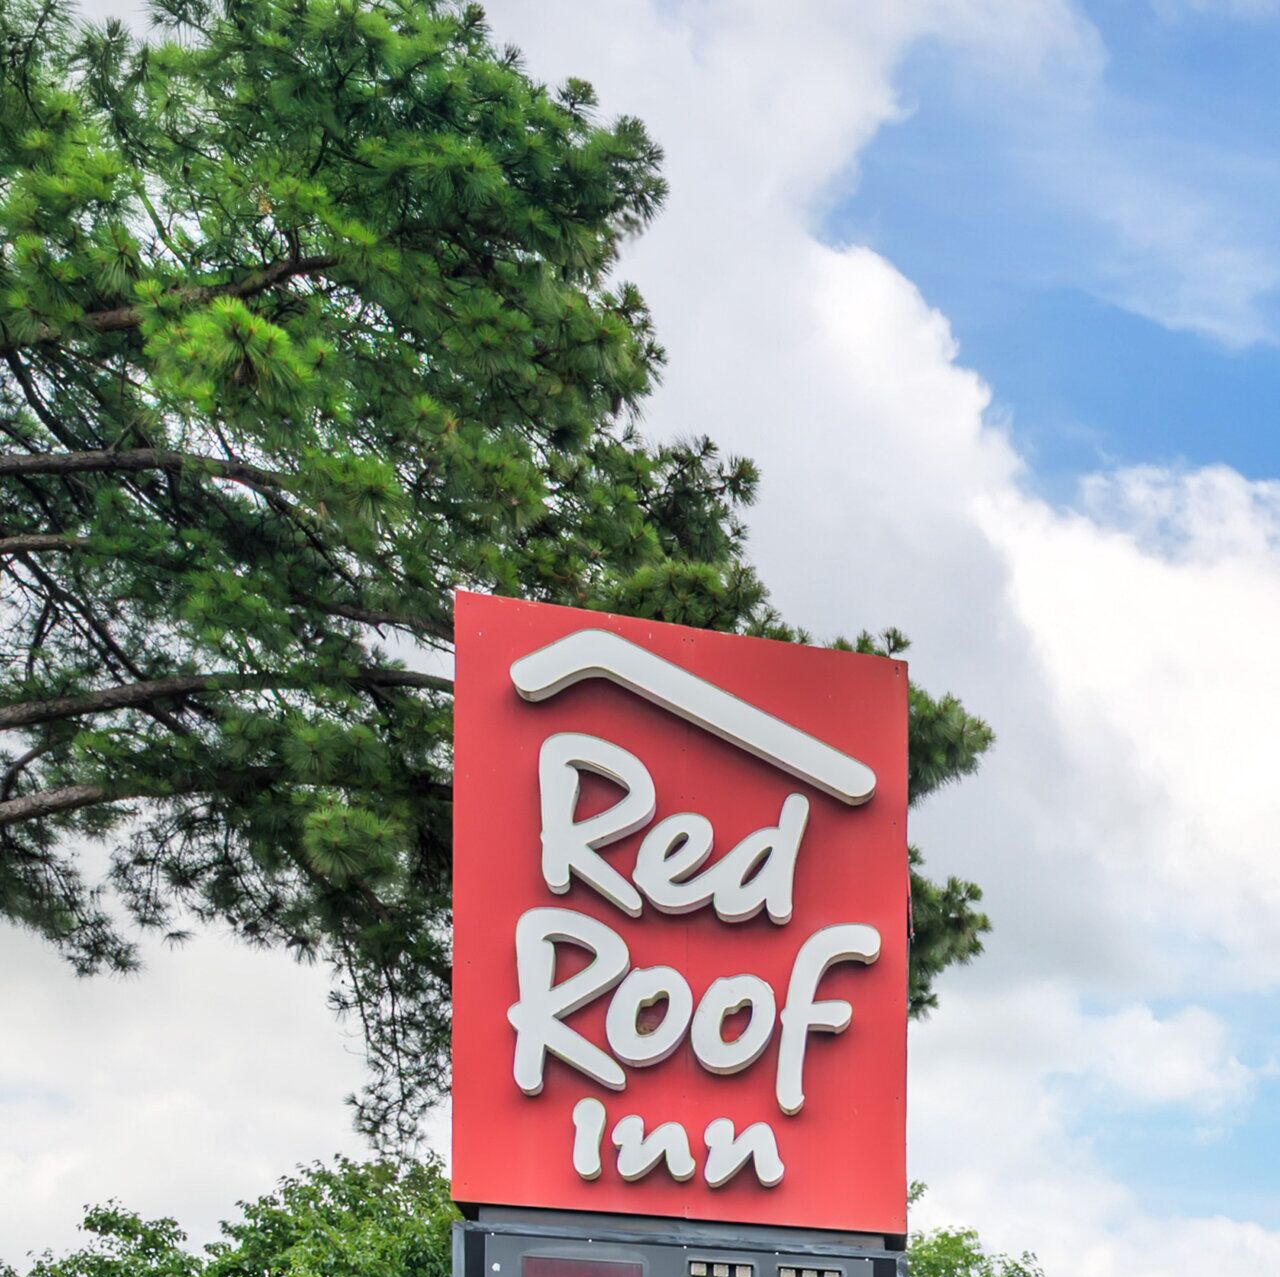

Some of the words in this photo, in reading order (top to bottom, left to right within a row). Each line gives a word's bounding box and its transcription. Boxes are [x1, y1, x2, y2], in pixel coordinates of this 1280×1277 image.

[538, 732, 810, 926] Red
[507, 906, 882, 1116] Roof
[572, 1097, 785, 1188] Inn
